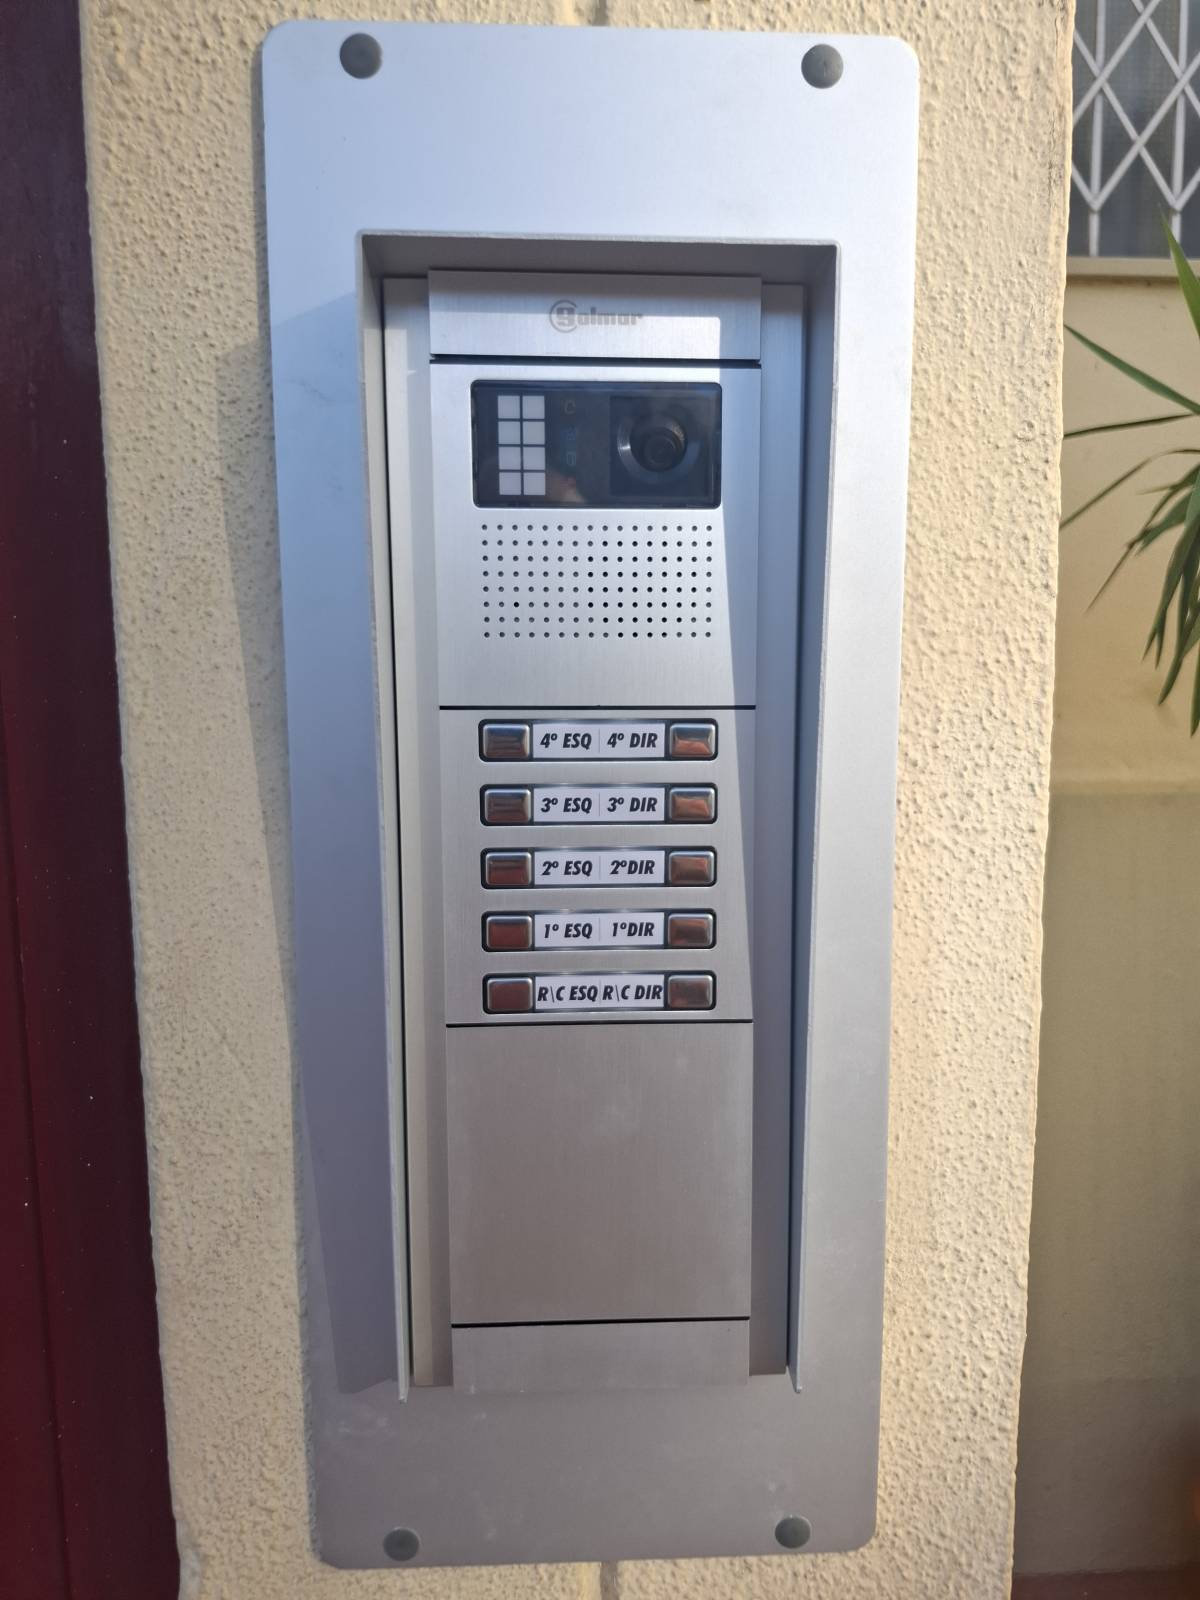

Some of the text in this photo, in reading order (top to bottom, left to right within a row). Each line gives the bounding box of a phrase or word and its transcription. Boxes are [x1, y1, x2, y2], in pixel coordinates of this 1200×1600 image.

[563, 733, 591, 750] ESQ
[630, 733, 657, 748] DIR
[563, 798, 592, 814] ESQ
[630, 797, 657, 812] DIR
[564, 861, 592, 876] ESQ
[564, 923, 592, 939] ESQ
[537, 986, 598, 1002] R\C ESQ
[603, 985, 663, 1001] R\C DIR
